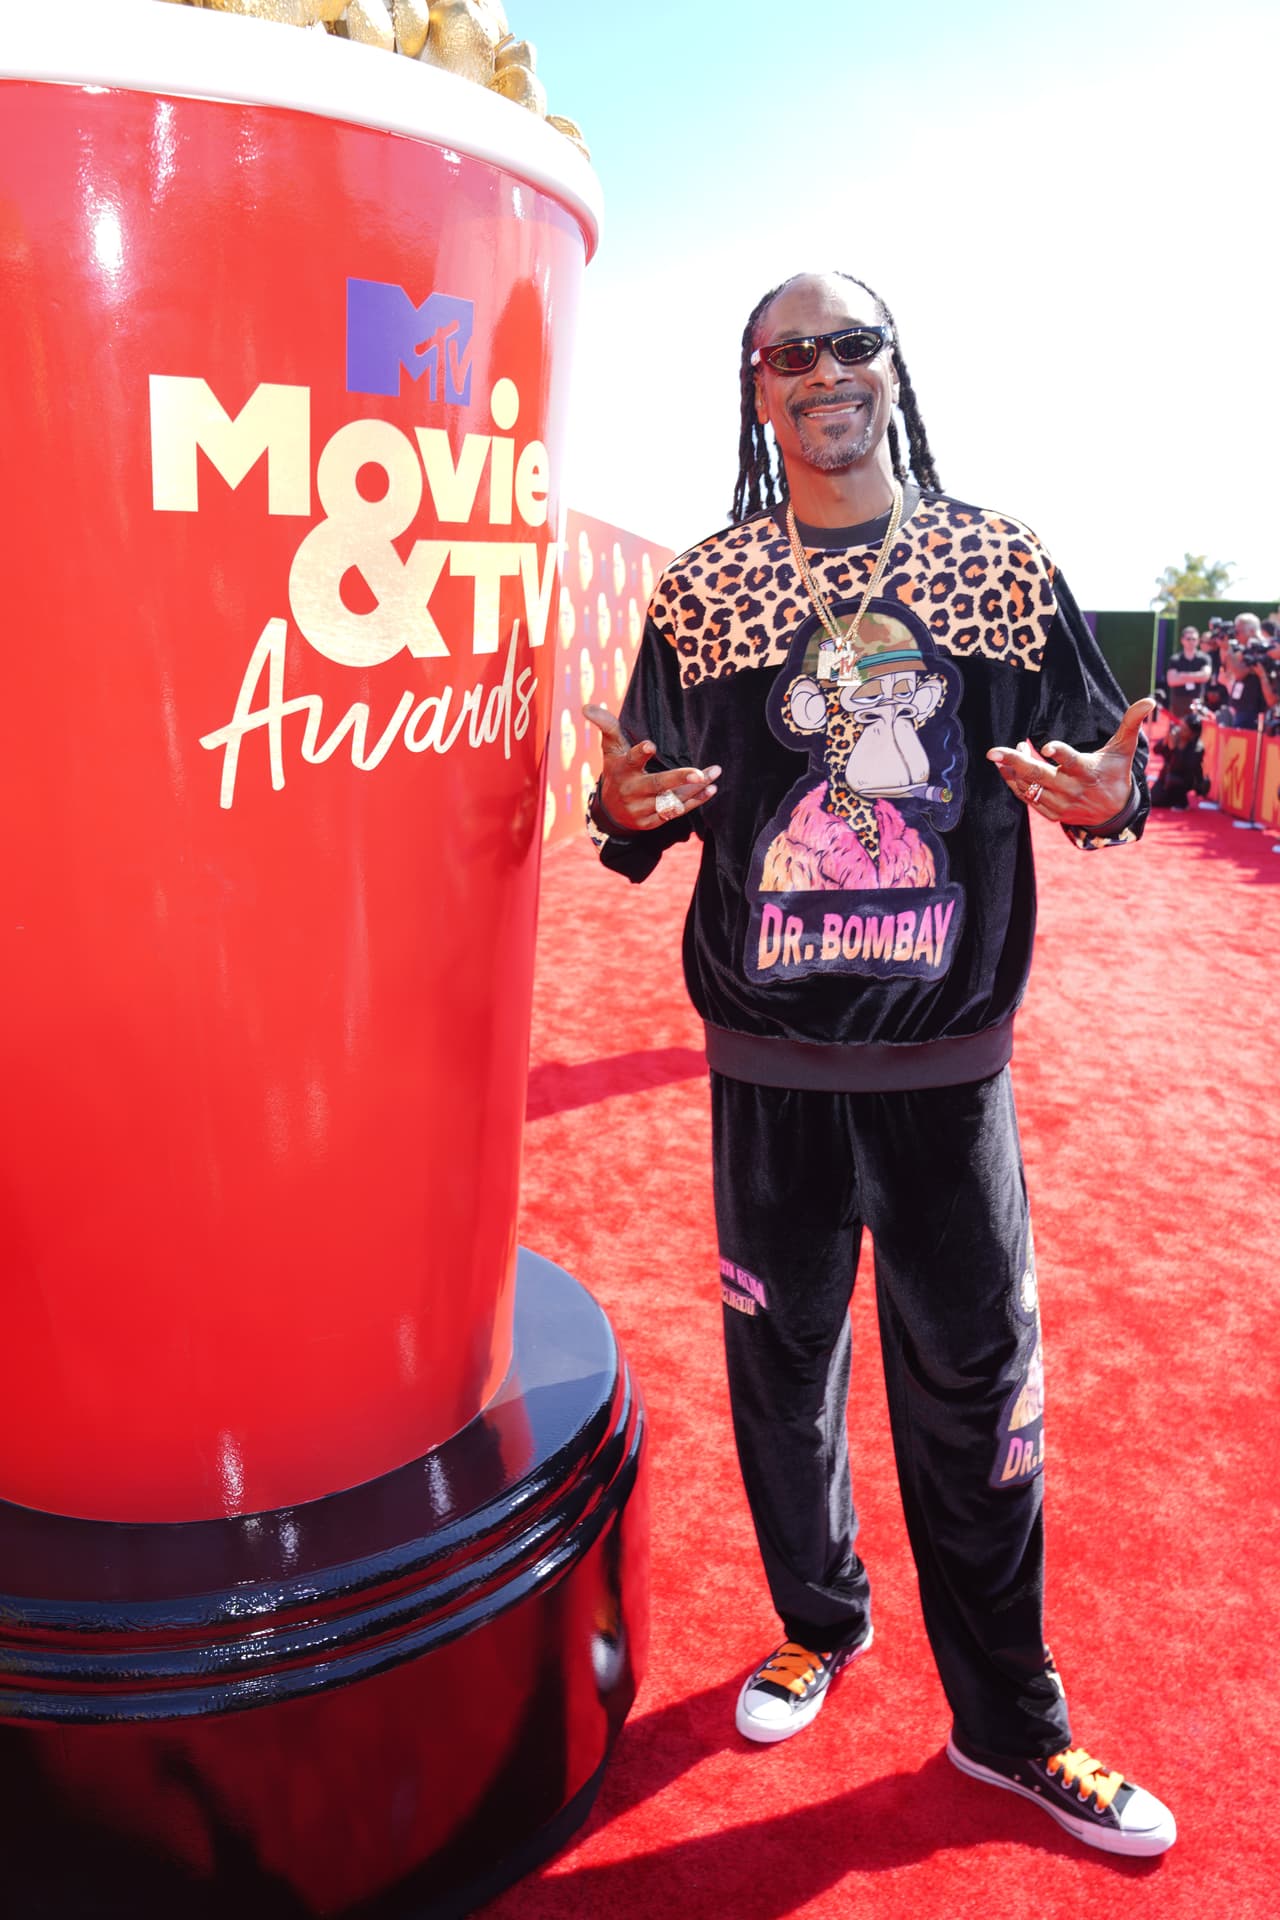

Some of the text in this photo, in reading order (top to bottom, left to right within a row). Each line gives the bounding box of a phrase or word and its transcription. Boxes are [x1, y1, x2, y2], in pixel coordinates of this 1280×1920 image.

[346, 277, 475, 407] MTV
[149, 374, 550, 535] Movie
[199, 617, 538, 810] Awards
[757, 900, 955, 970] DR. BOMBAY
